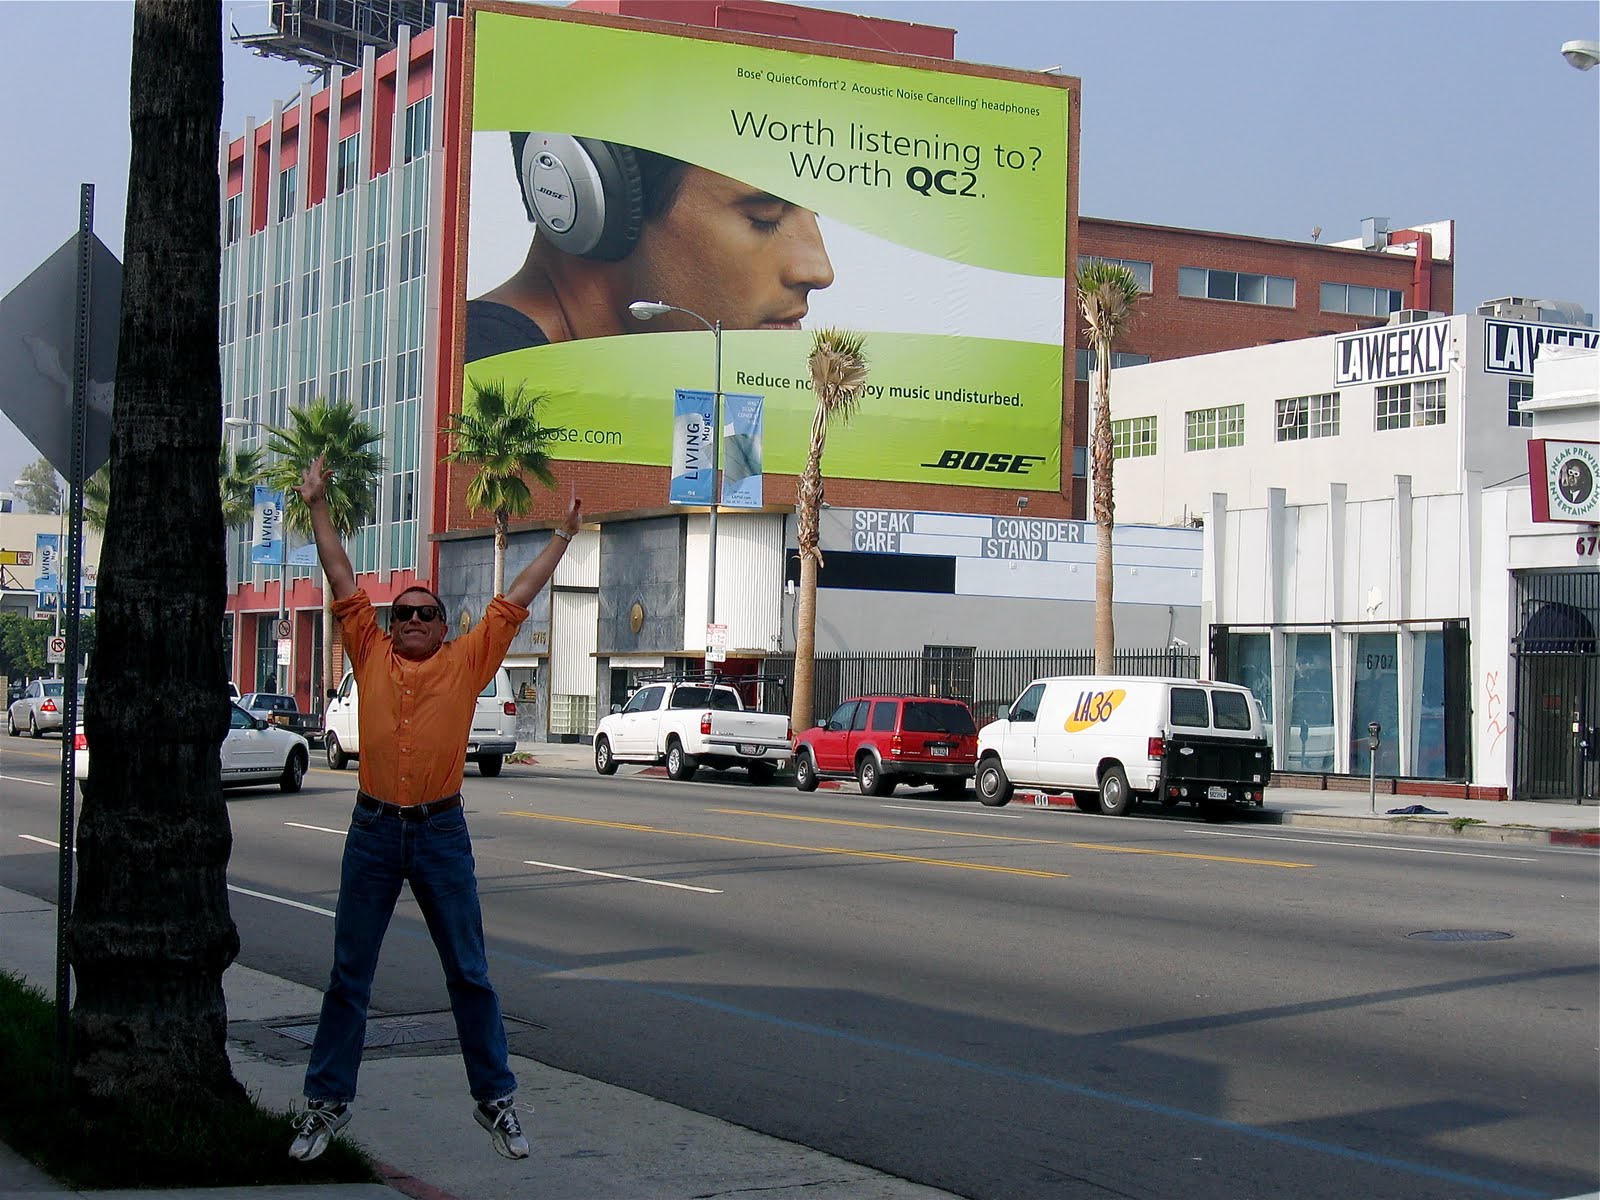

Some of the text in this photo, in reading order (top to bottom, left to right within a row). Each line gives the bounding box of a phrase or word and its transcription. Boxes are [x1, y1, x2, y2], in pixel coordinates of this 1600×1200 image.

[851, 83, 893, 98] Acoustic
[896, 88, 924, 101] Noise
[926, 92, 977, 110] Cancelling
[981, 99, 1040, 117] headphones
[730, 109, 1042, 172] Worth listening to?
[789, 151, 986, 199] Worth QC2.
[536, 186, 568, 200] BOSE
[1366, 323, 1449, 381] WEEKLY
[737, 371, 790, 389] Reduce
[889, 385, 930, 401] music
[935, 388, 1024, 408] undisturbed.
[701, 412, 711, 442] Music
[684, 422, 700, 481] LIVING
[921, 450, 1046, 474] BOSE
[1550, 448, 1572, 476] SNEAK
[1549, 481, 1600, 516] ENTERTAINMENT
[261, 508, 273, 548] LIVING
[854, 510, 910, 533] SPEAK
[996, 519, 1080, 543] CONSIDER
[854, 531, 896, 553] CARE
[986, 538, 1043, 560] STAND
[1576, 536, 1600, 556] 67
[41, 550, 51, 580] LIVING
[1366, 654, 1393, 670] 6707
[1073, 690, 1115, 723] LA36
